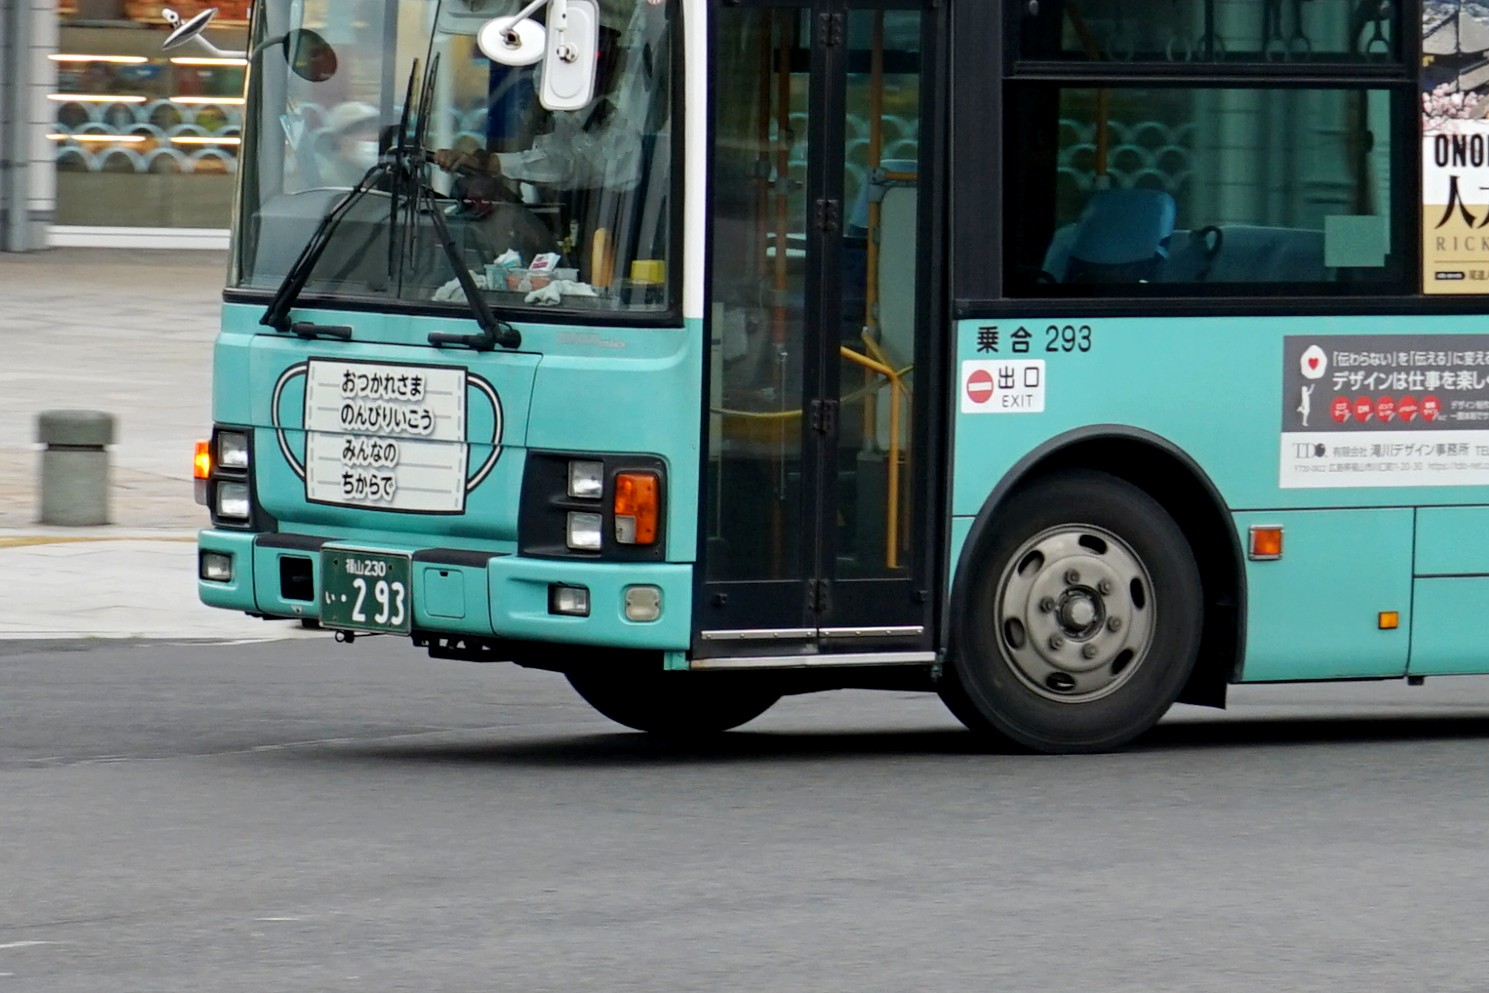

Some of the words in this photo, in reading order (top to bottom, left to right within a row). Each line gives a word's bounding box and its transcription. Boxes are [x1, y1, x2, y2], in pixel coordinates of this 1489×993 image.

[976, 326, 1033, 354] 乗合
[1045, 324, 1092, 353] 293
[341, 368, 425, 398] おつかれさま
[998, 366, 1039, 389] 出口
[1001, 394, 1034, 408] EXIT
[340, 402, 433, 432] のんびりいこう
[341, 440, 398, 466] みんなの
[341, 471, 397, 500] ちからで
